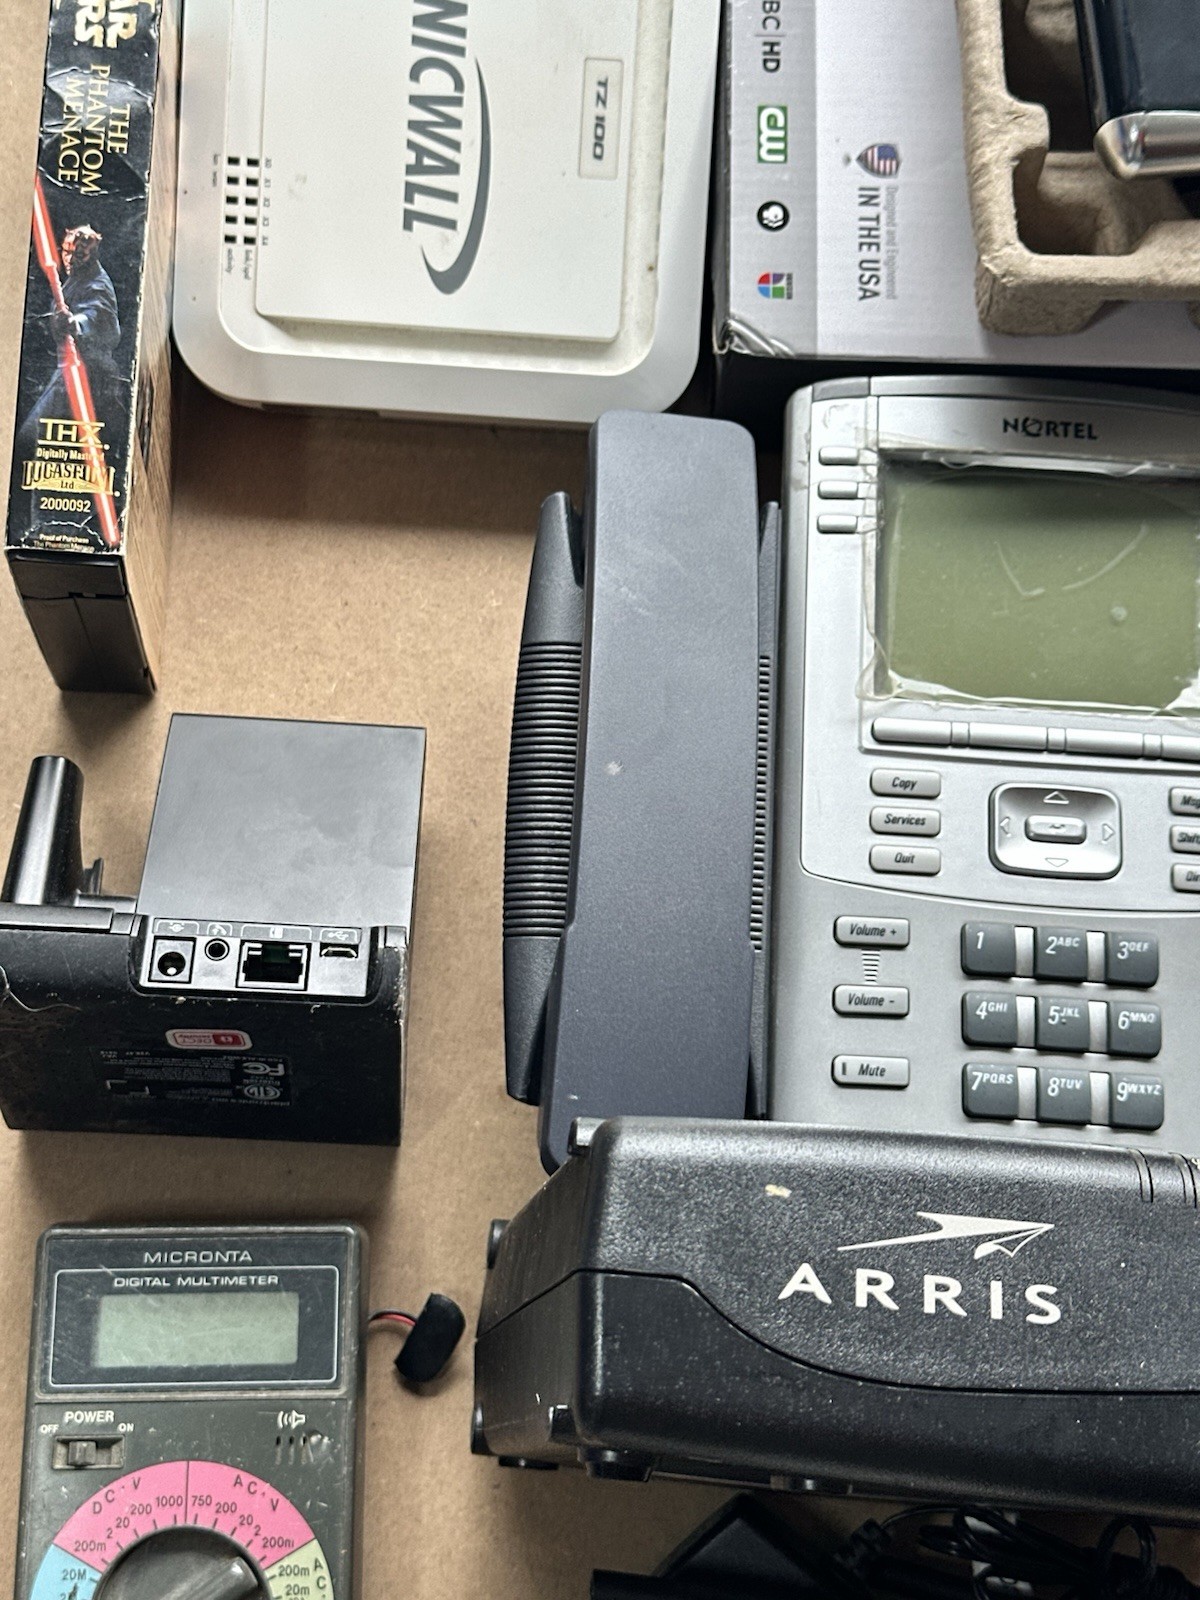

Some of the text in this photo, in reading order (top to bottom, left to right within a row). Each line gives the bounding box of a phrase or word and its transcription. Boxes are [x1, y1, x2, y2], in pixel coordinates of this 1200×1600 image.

[592, 75, 609, 161] TZ 100
[58, 76, 87, 182] MENACE
[81, 64, 110, 195] PHANTOM
[107, 103, 131, 154] THE
[858, 187, 880, 301] IN THE USA
[886, 230, 898, 247] and
[1002, 416, 1098, 442] NORTEL
[36, 447, 69, 461] Digitally
[60, 480, 74, 490] Ltd
[39, 497, 91, 513] 2000092
[891, 776, 917, 791] Copy
[884, 813, 926, 827] Services
[894, 852, 916, 865] Quit
[849, 924, 885, 937] Volume
[975, 931, 985, 950] 1
[847, 993, 884, 1006] Volume
[858, 1063, 886, 1078] Mute
[144, 1250, 253, 1264] MICRONTA
[113, 1274, 279, 1288] DIGITAL MULTIMETER
[777, 1262, 1062, 1326] ARRIS
[65, 1410, 114, 1424] POWER
[40, 1423, 135, 1434] OFF ON
[156, 1495, 183, 1507] 1000
[191, 1495, 213, 1507] 750
[130, 1503, 152, 1515] 200
[215, 1502, 238, 1514] 200
[115, 1517, 130, 1529] 20
[239, 1514, 254, 1526] 20
[106, 1528, 114, 1540] 2
[254, 1524, 262, 1537] 2
[74, 1540, 107, 1552] 200m
[262, 1537, 294, 1549] 200m
[61, 1569, 87, 1581] 20M
[278, 1565, 310, 1578] 200m
[285, 1583, 310, 1596] 20m
